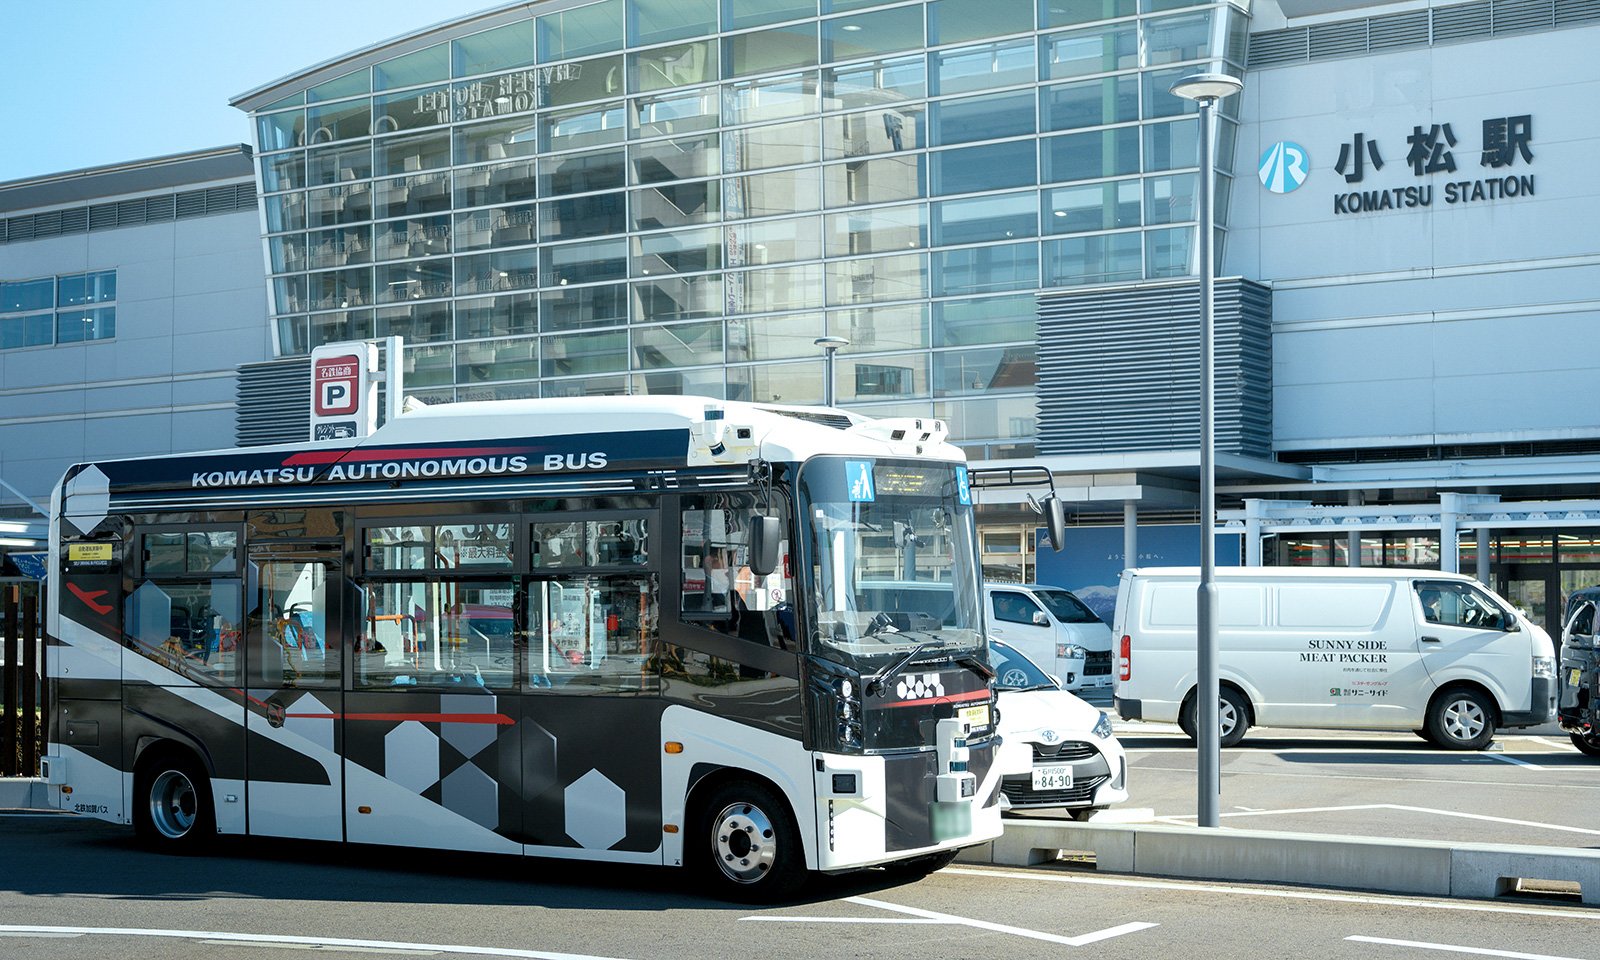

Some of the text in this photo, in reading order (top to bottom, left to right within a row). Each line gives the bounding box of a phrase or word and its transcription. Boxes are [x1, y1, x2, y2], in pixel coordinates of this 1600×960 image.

[1334, 114, 1534, 183] 小松駅
[1334, 175, 1535, 214] KOMATSU STATION
[321, 366, 352, 377] 名鉄協商
[327, 385, 346, 406] P
[192, 452, 608, 488] KOMATSU AUTONOMOUS BUS
[1308, 639, 1387, 650] SUNNY SIDE
[1299, 653, 1387, 663] MEAT PACKER
[1041, 775, 1071, 788] 84-90
[74, 803, 109, 814] 北鉄加賀バス
